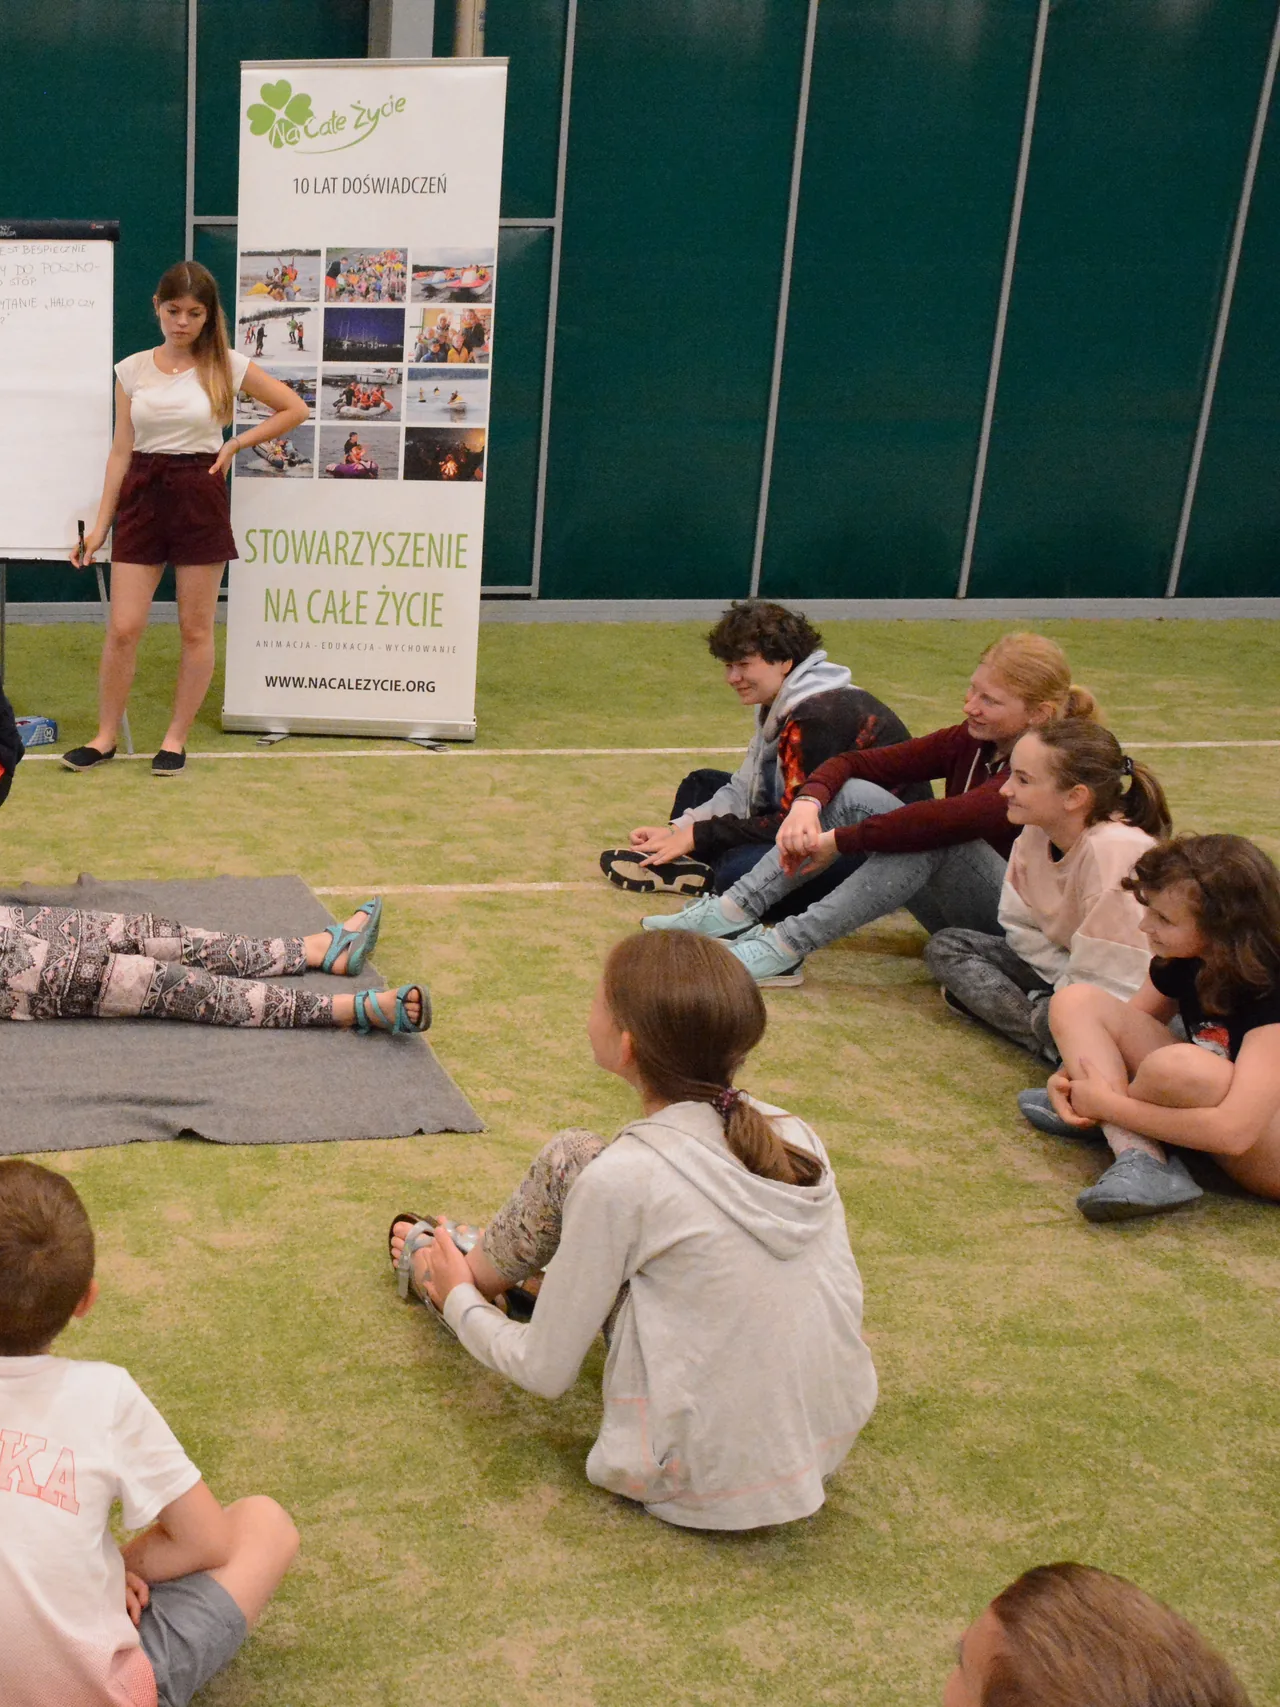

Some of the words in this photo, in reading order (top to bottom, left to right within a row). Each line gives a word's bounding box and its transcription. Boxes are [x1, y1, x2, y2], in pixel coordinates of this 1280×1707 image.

[271, 123, 301, 146] Na
[304, 110, 347, 139] Całe
[350, 94, 407, 132] Życie
[293, 177, 310, 194] 10
[314, 176, 338, 194] LAT
[343, 173, 447, 194] DOŚWIADCZEŃ
[16, 264, 34, 276] DO
[244, 528, 469, 569] STOWARZYSZENIE
[264, 588, 299, 624] NA
[307, 589, 368, 625] CAŁE
[375, 584, 445, 628] ŻYCIE
[255, 640, 311, 649] ANIMACJA
[321, 641, 375, 651] EDUKACJA
[385, 644, 457, 654] WYCHOWANIE
[265, 675, 436, 693] WWW.NACALEZYCIE.ORG
